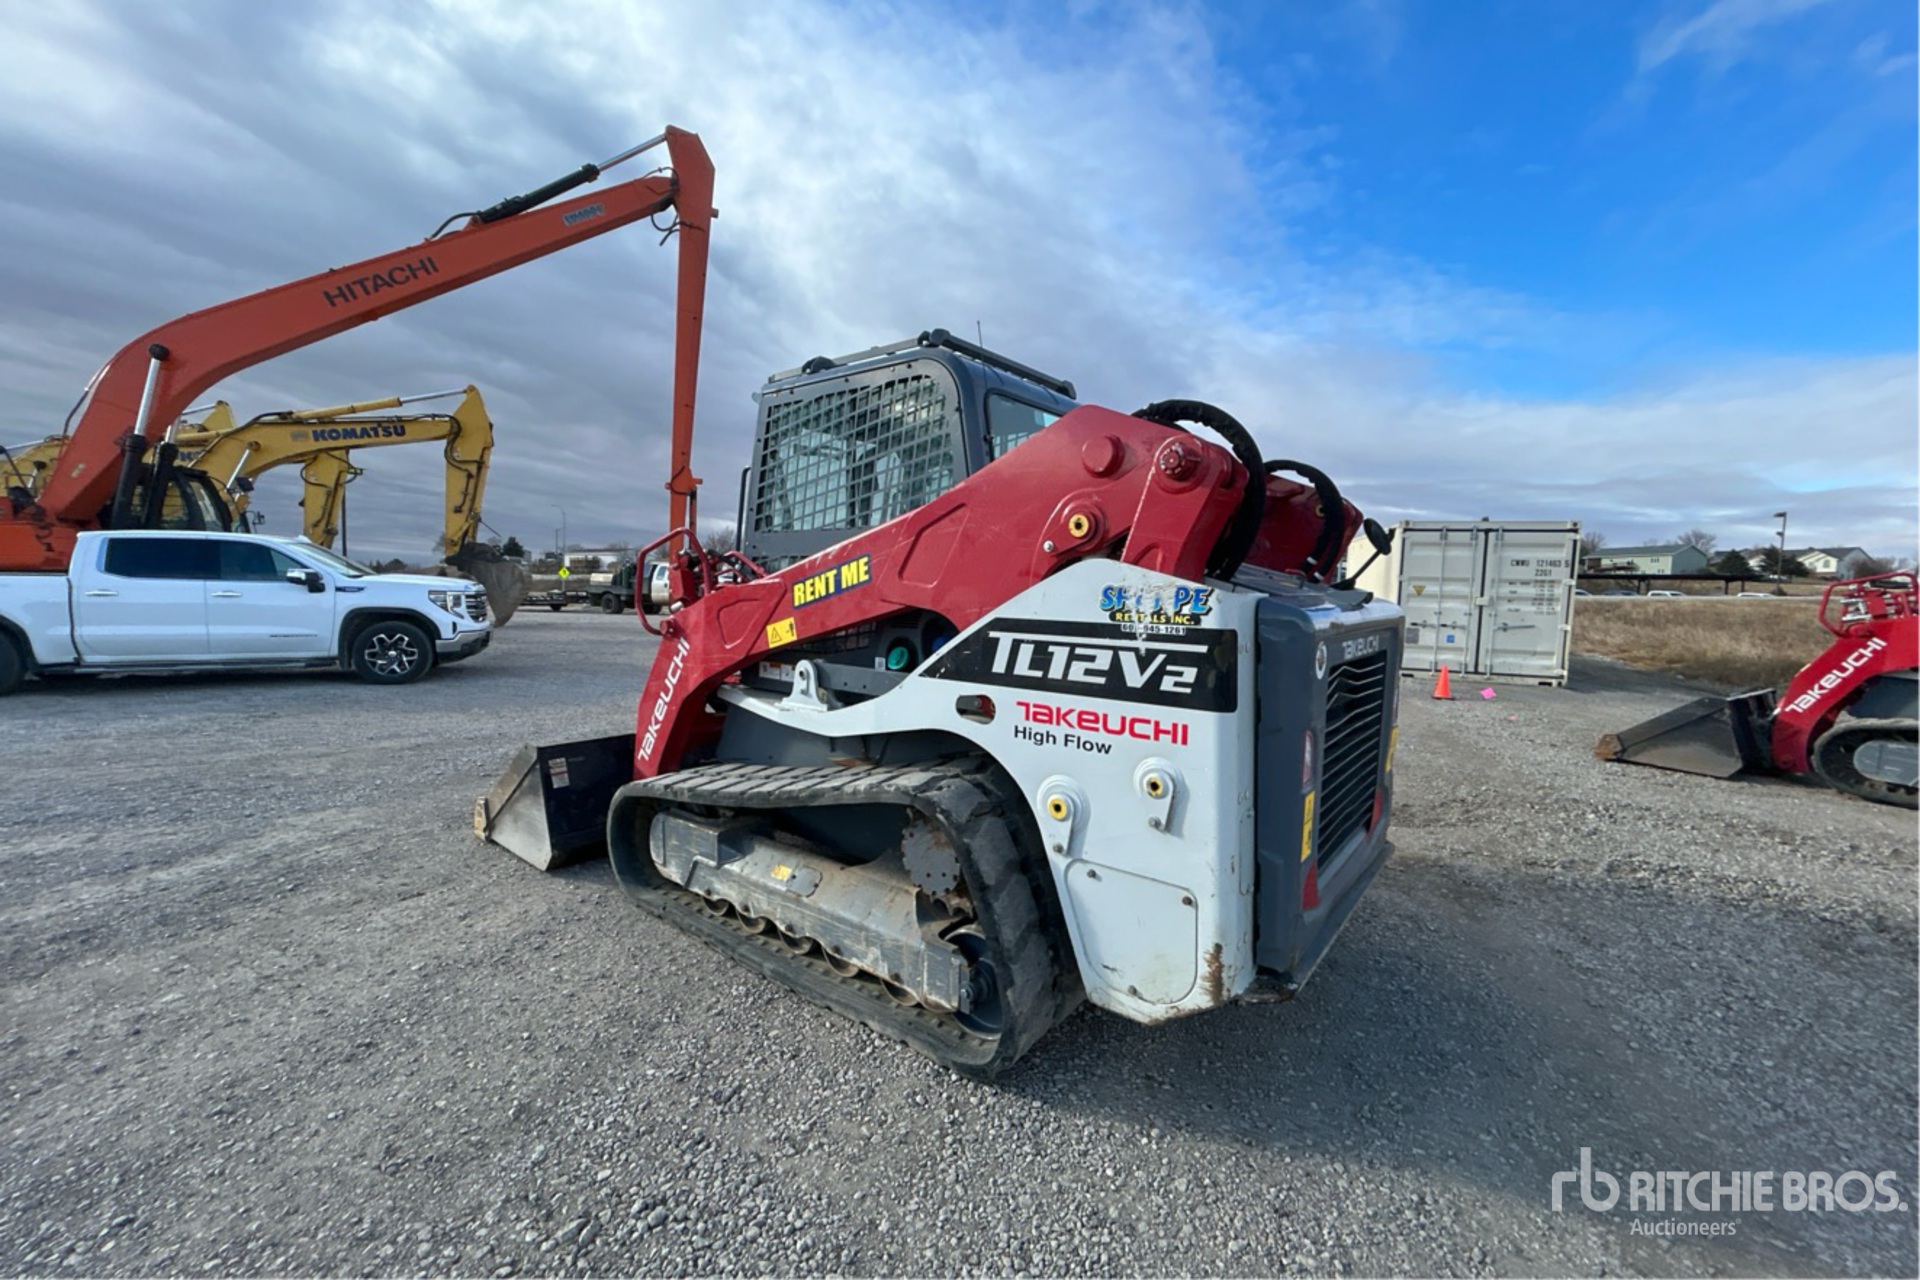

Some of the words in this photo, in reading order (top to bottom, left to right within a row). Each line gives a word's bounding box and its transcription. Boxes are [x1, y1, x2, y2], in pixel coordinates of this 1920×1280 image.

[323, 256, 439, 307] HITACHI
[312, 424, 406, 442] KOMATSU
[793, 569, 837, 607] RENT
[841, 556, 869, 589] ME
[1122, 623, 1186, 636] 60-945-1261
[987, 630, 1209, 694] TL12V2
[1784, 637, 1888, 713] TAKEUCHI
[637, 636, 691, 761] TAKEUCHI
[1016, 701, 1189, 746] TAKEUCHI
[1014, 725, 1057, 746] High
[1064, 734, 1113, 755] Flow
